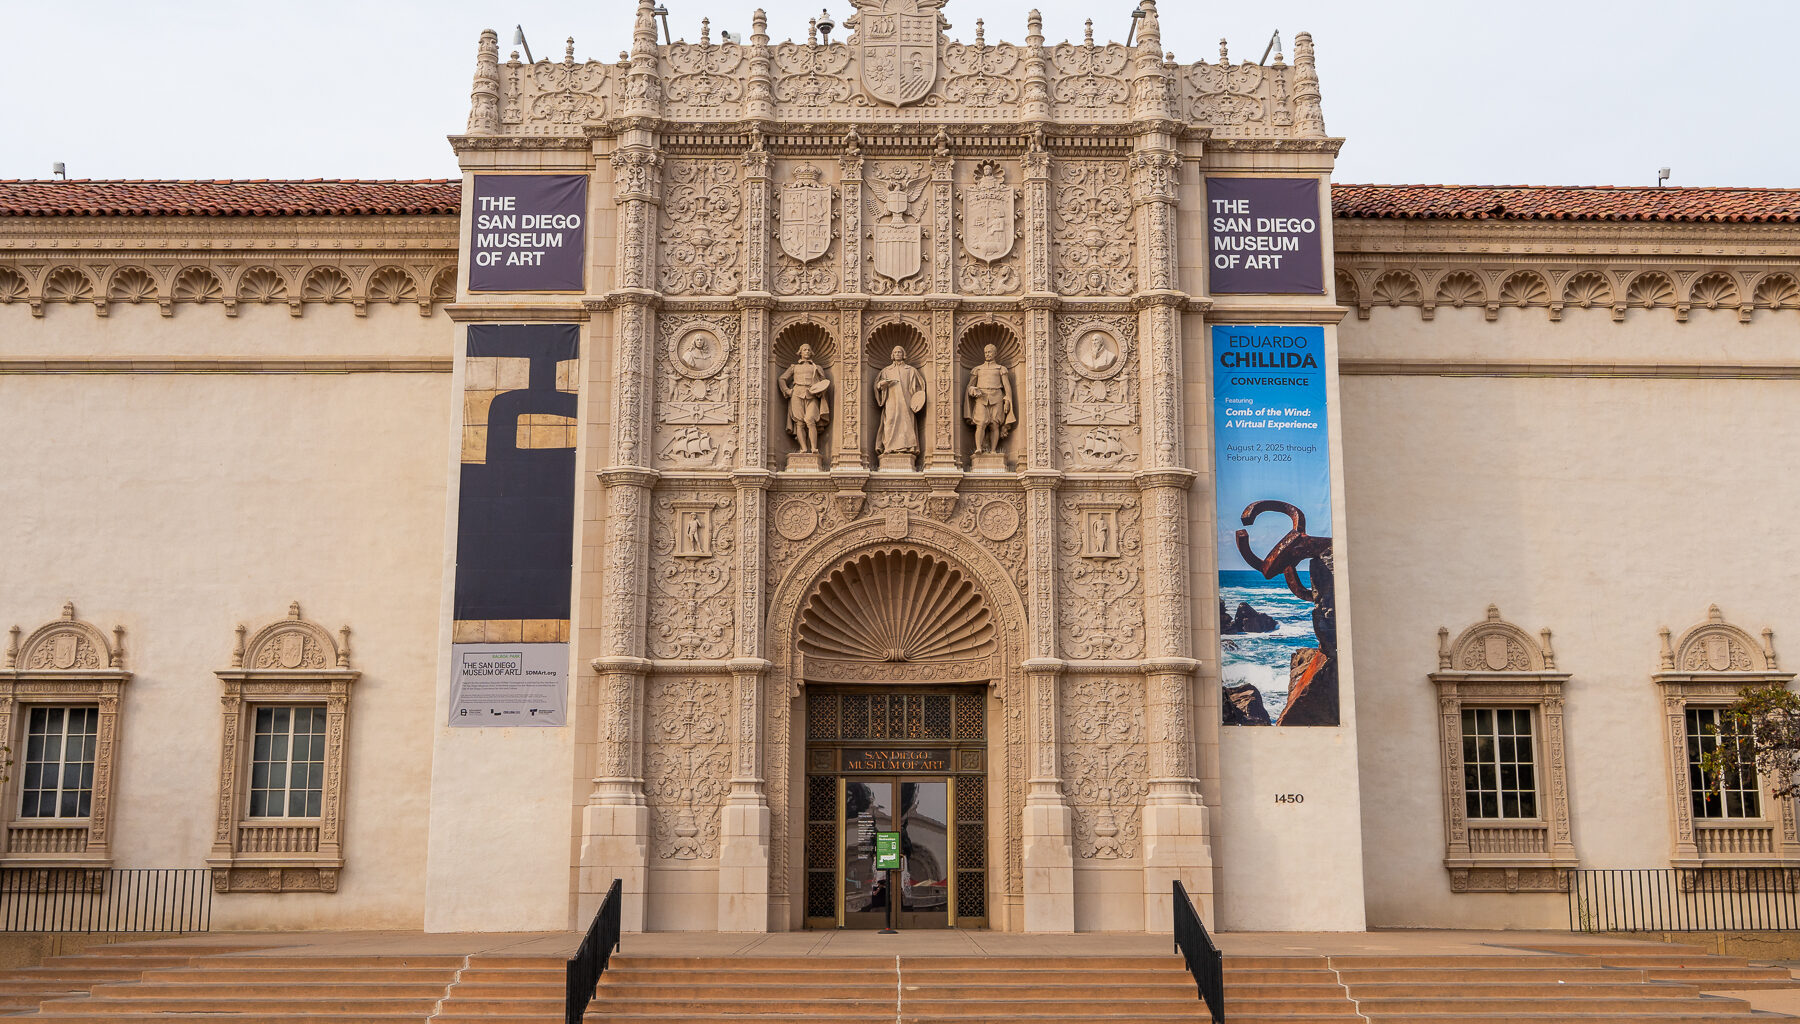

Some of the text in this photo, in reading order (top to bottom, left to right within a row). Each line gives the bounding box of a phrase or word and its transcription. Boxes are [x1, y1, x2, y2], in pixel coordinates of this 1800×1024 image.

[479, 197, 515, 211] THE
[1212, 200, 1249, 214] THE
[478, 214, 580, 229] SAN DIEGO
[1213, 218, 1315, 233] SAN DIEGO
[477, 233, 562, 247] MUSEUM
[1214, 236, 1298, 251] MUSEUM
[476, 252, 544, 266] OF ART
[1214, 255, 1282, 269] OF ART
[1230, 336, 1307, 348] EDUARDO
[1220, 352, 1318, 368] CHILLIDA
[1226, 408, 1253, 416] Comb
[1268, 421, 1318, 430] Experience
[1286, 444, 1316, 453] through
[1227, 454, 1261, 463] February
[849, 761, 899, 769] MUSEUM
[921, 761, 944, 769] ART
[1275, 794, 1304, 803] 1450
